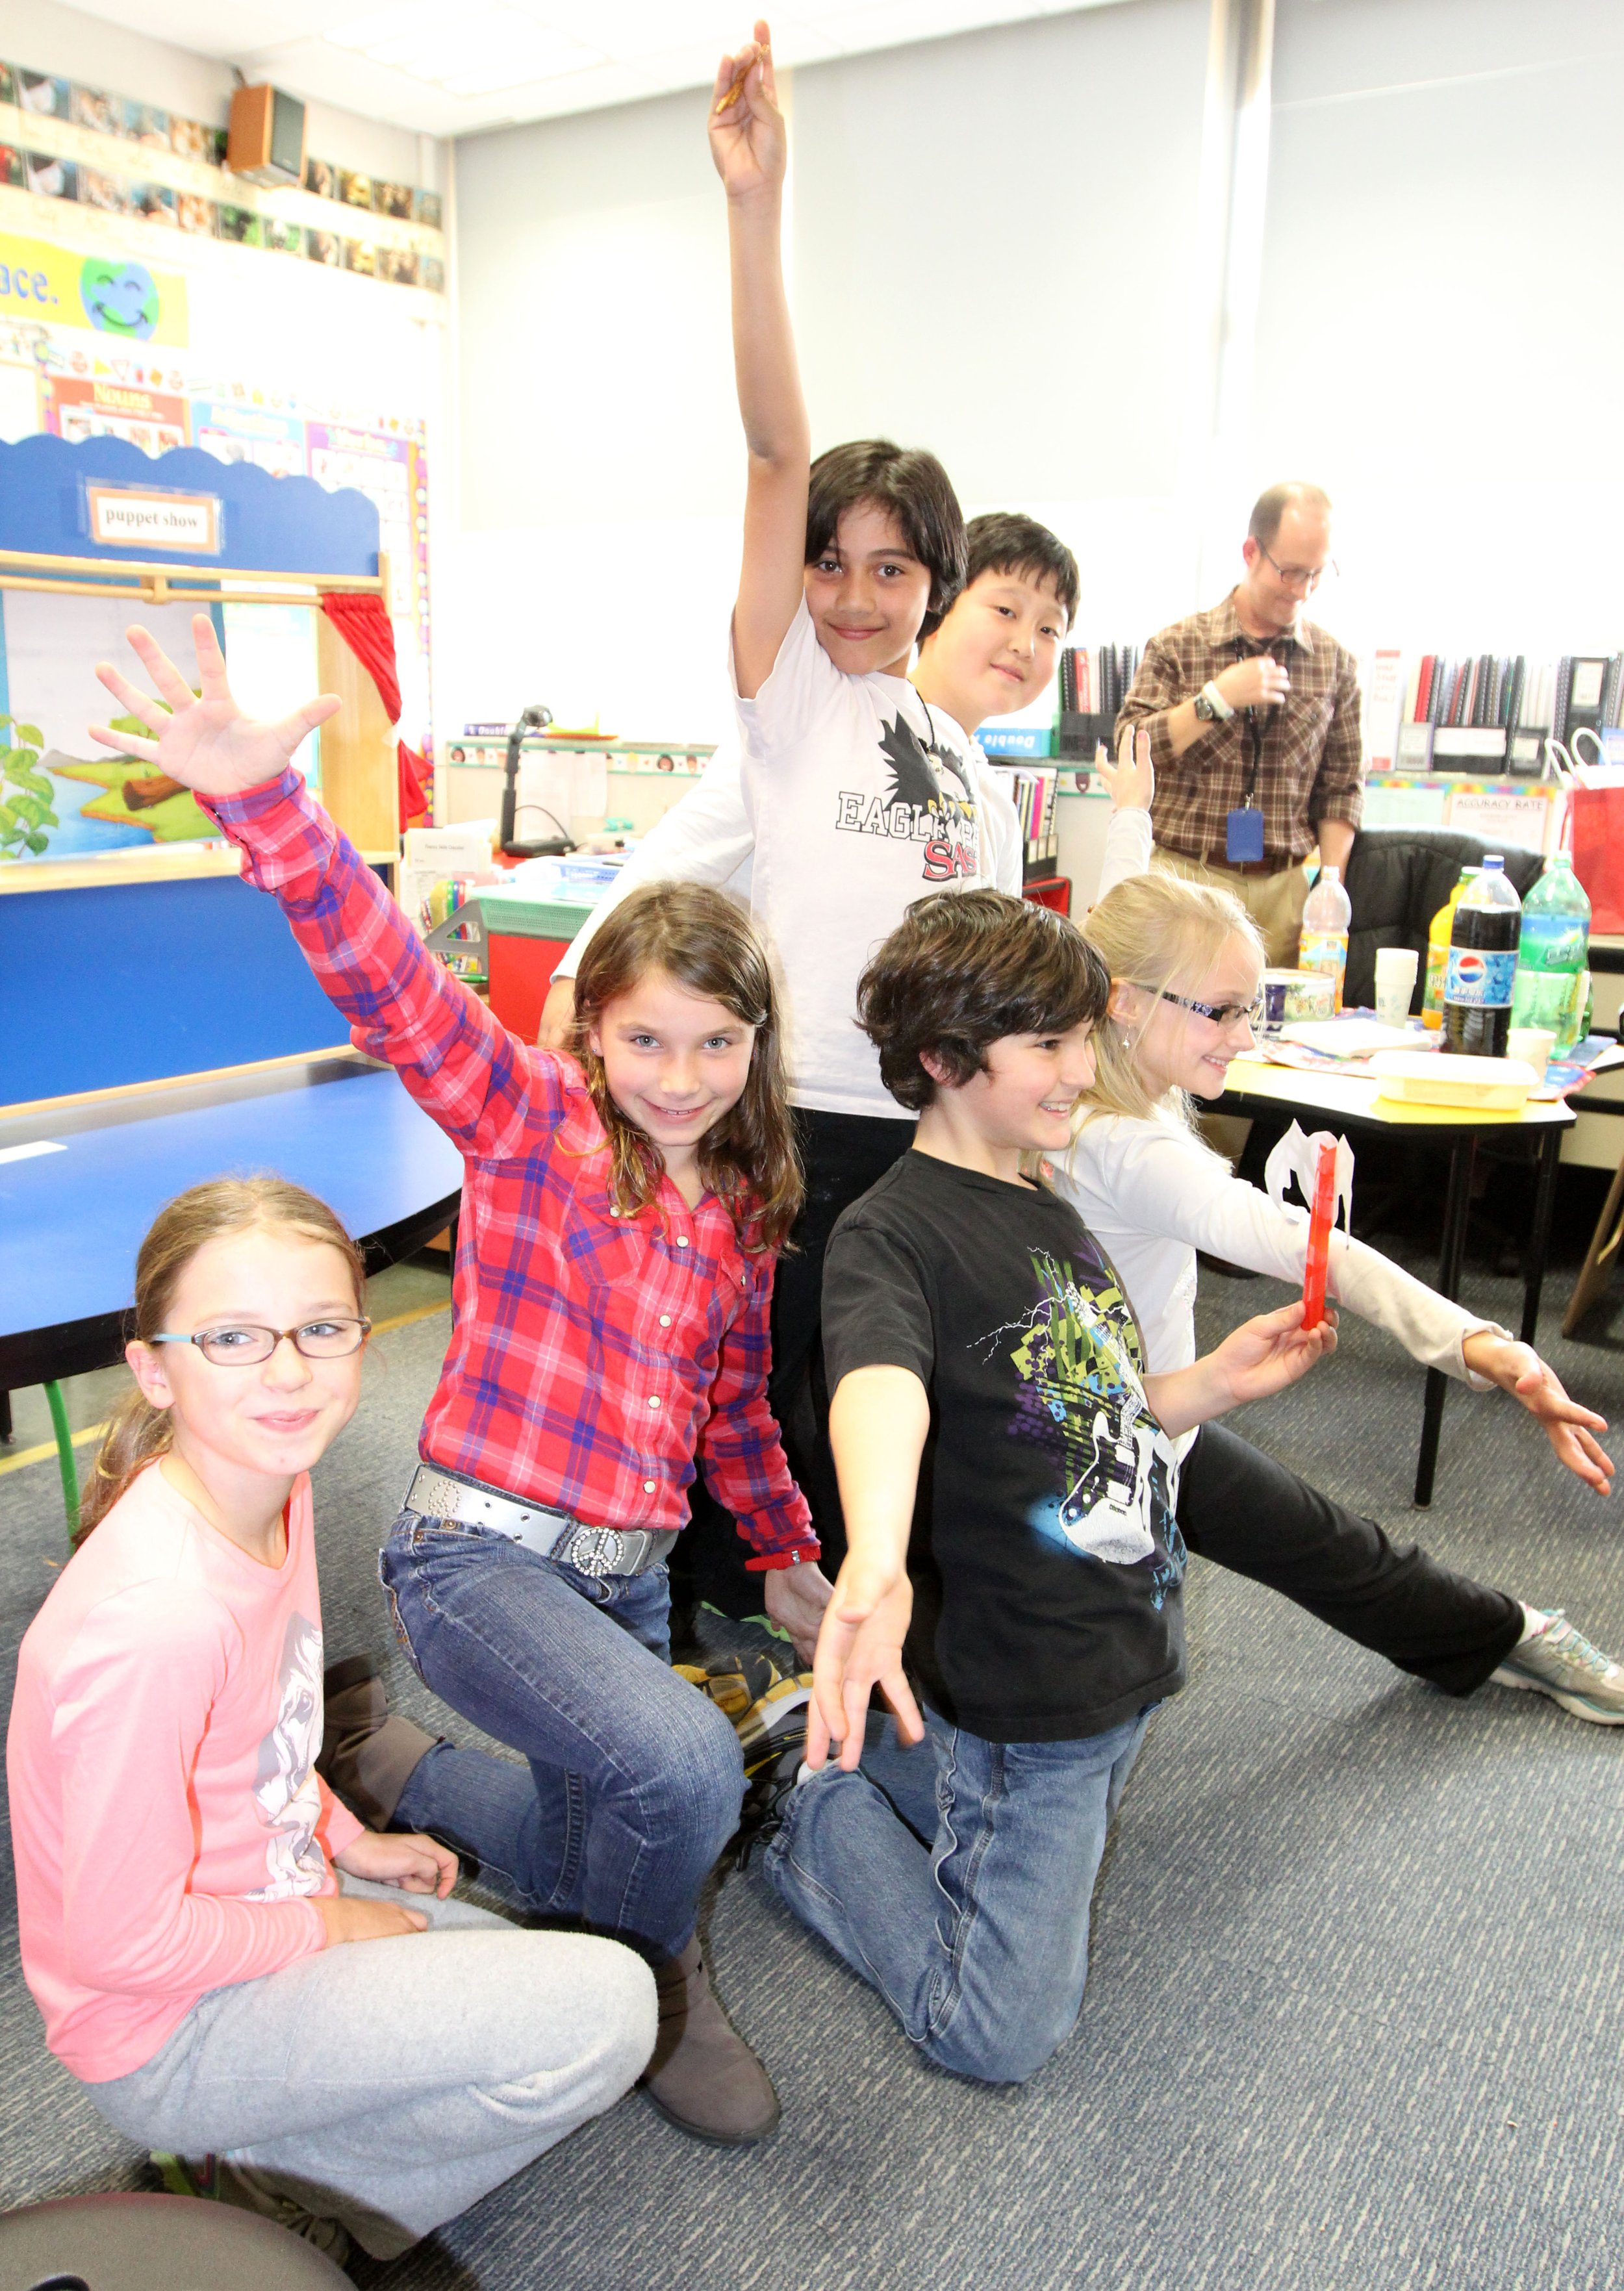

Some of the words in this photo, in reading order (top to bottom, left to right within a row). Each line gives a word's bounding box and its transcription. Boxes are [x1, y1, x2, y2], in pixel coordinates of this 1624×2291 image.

[93, 381, 152, 409] Nouns
[105, 509, 159, 527] puppet
[162, 511, 198, 528] show
[984, 734, 1035, 749] Double
[1456, 798, 1511, 811] ACCURACY
[1515, 799, 1544, 811] RATE
